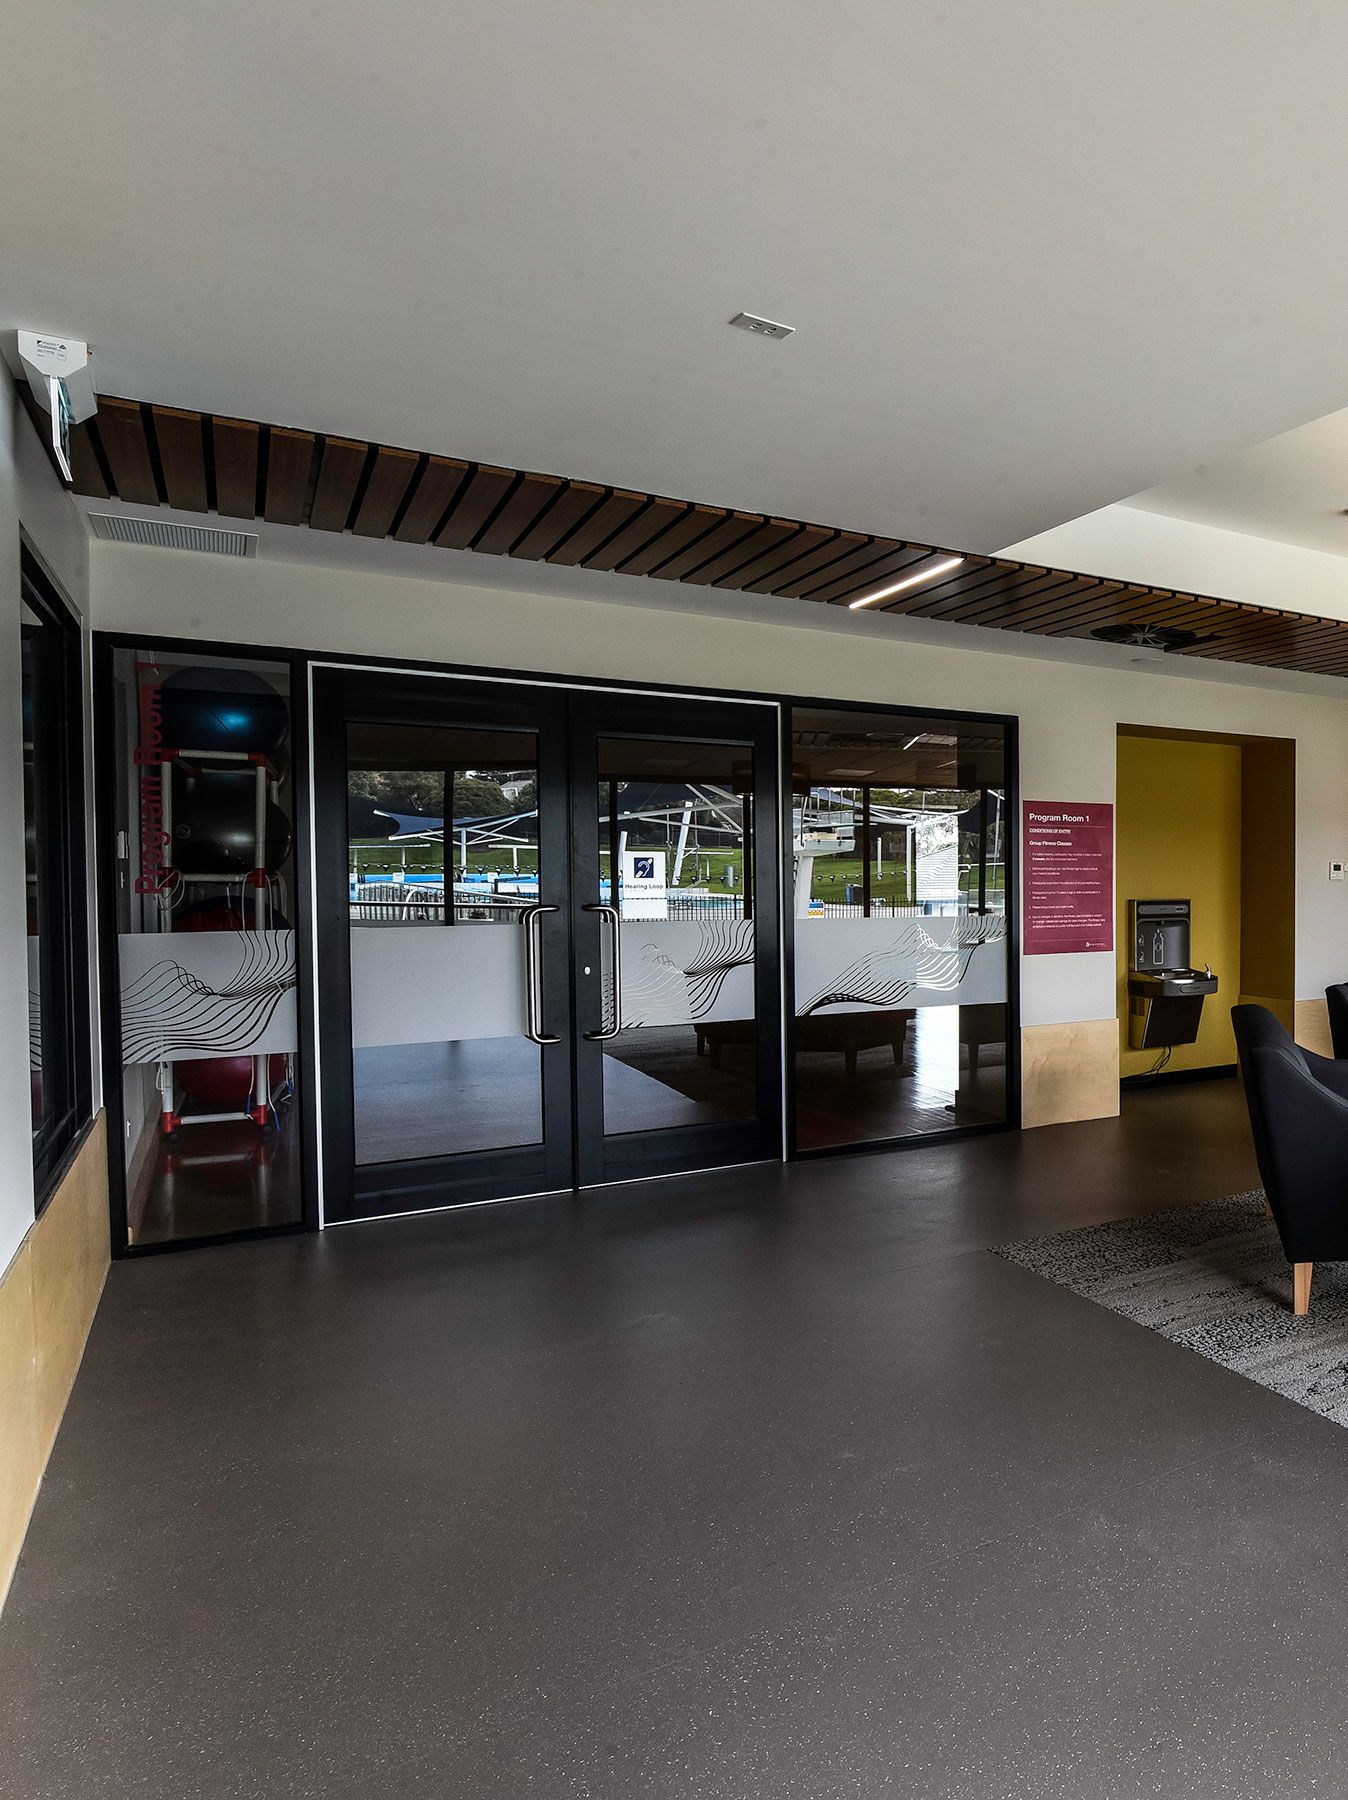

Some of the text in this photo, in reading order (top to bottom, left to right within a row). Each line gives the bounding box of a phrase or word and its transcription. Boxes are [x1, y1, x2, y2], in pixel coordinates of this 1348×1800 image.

[134, 685, 163, 765] Room
[134, 776, 171, 894] Program
[1029, 812, 1061, 823] Program
[1062, 814, 1084, 822] Room
